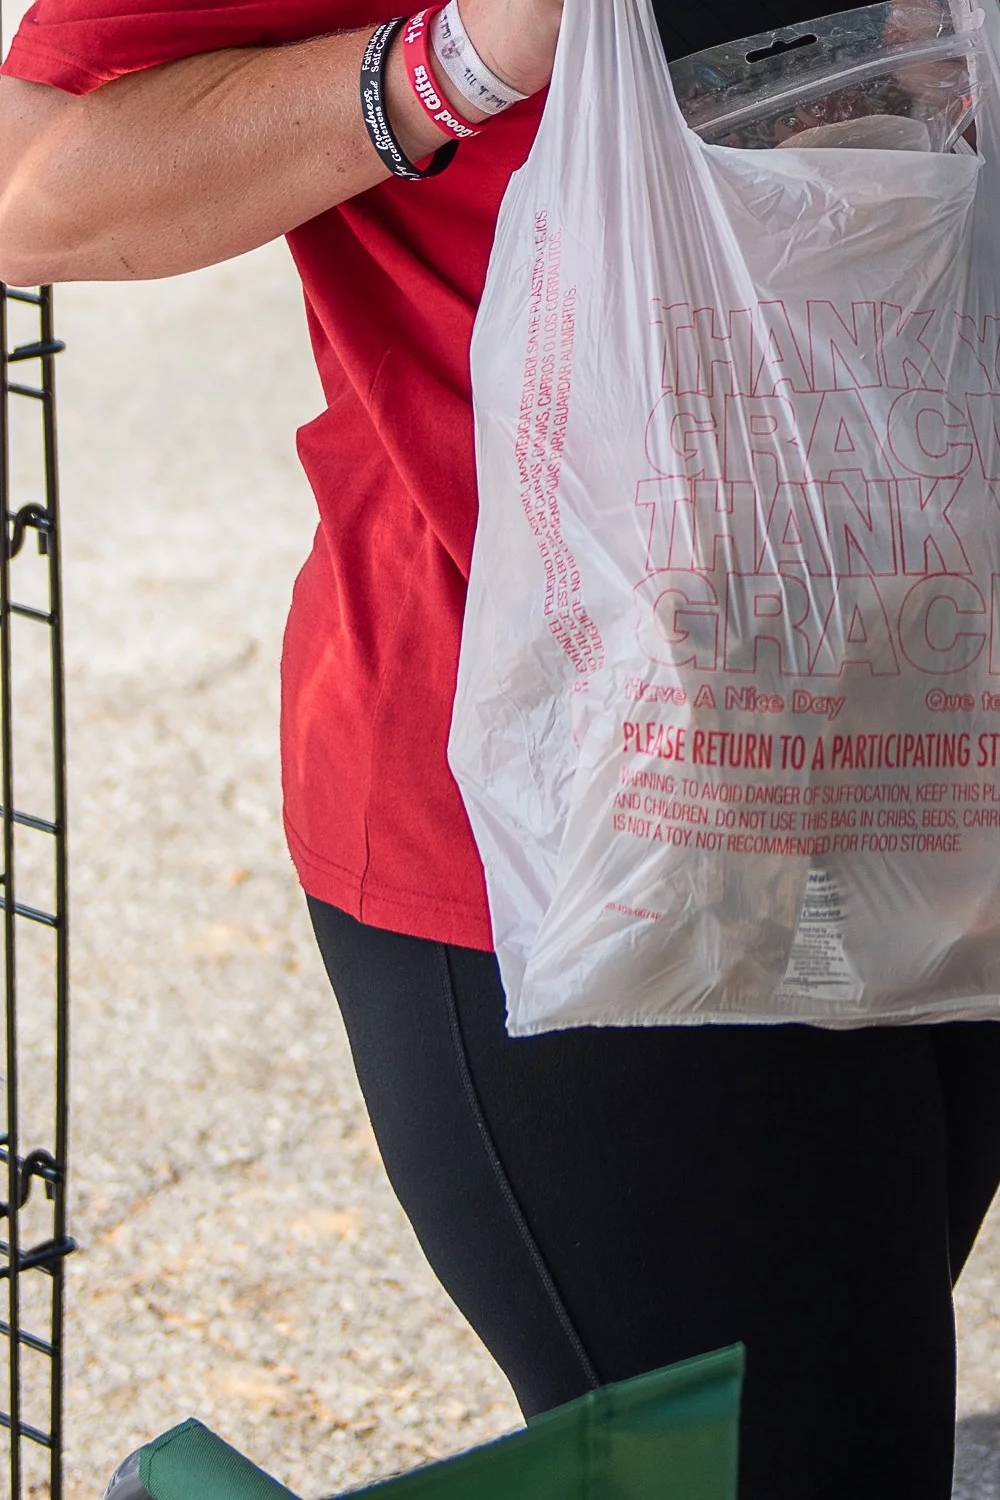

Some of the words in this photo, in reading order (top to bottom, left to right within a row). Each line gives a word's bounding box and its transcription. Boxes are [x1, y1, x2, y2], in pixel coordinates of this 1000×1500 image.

[370, 80, 380, 102] and
[413, 64, 442, 111] Gifts
[364, 87, 389, 151] Goodness
[375, 105, 402, 162] Gentleness
[434, 109, 473, 139] Good
[528, 316, 541, 335] DE
[543, 313, 557, 340] LOS
[560, 284, 577, 361] ALIMENTOS.
[524, 336, 539, 378] BOLSA
[649, 298, 948, 398] THANK
[520, 378, 536, 412] ESTA
[537, 354, 555, 407] CARROS
[553, 363, 572, 427] GUARDAR
[634, 476, 974, 577] THANK
[543, 559, 556, 616] PELIGRO
[557, 573, 568, 608] ESTA
[570, 570, 580, 593] NO
[623, 678, 687, 705] Have
[692, 684, 717, 709] A
[724, 686, 785, 713] Nice
[792, 689, 847, 722] Day
[924, 688, 976, 712] Que
[623, 721, 686, 762] PLEASE
[692, 729, 773, 770] RETURN
[780, 735, 806, 770] TO
[811, 735, 825, 770] A
[831, 732, 970, 770] PARTICIPATING
[613, 792, 642, 812] AND
[715, 808, 735, 828] DO
[739, 810, 766, 830] NOT
[770, 812, 796, 831] USE
[801, 811, 828, 831] THIS
[830, 810, 856, 828] BAG
[861, 810, 873, 828] IN
[877, 809, 918, 830] CRIBS,
[922, 809, 960, 830] BEDS,
[682, 777, 699, 799] TO
[701, 780, 743, 802] AVOID
[745, 782, 800, 805] DANGER
[804, 786, 821, 805] OF
[916, 783, 948, 801] KEEP
[951, 783, 980, 801] THIS
[613, 814, 626, 832] IS
[627, 815, 653, 838] NOT
[653, 823, 663, 842] A
[696, 830, 724, 850] NOT
[727, 832, 830, 857] RECOMMENDED
[833, 833, 858, 853] FOR
[861, 832, 897, 852] FOOD
